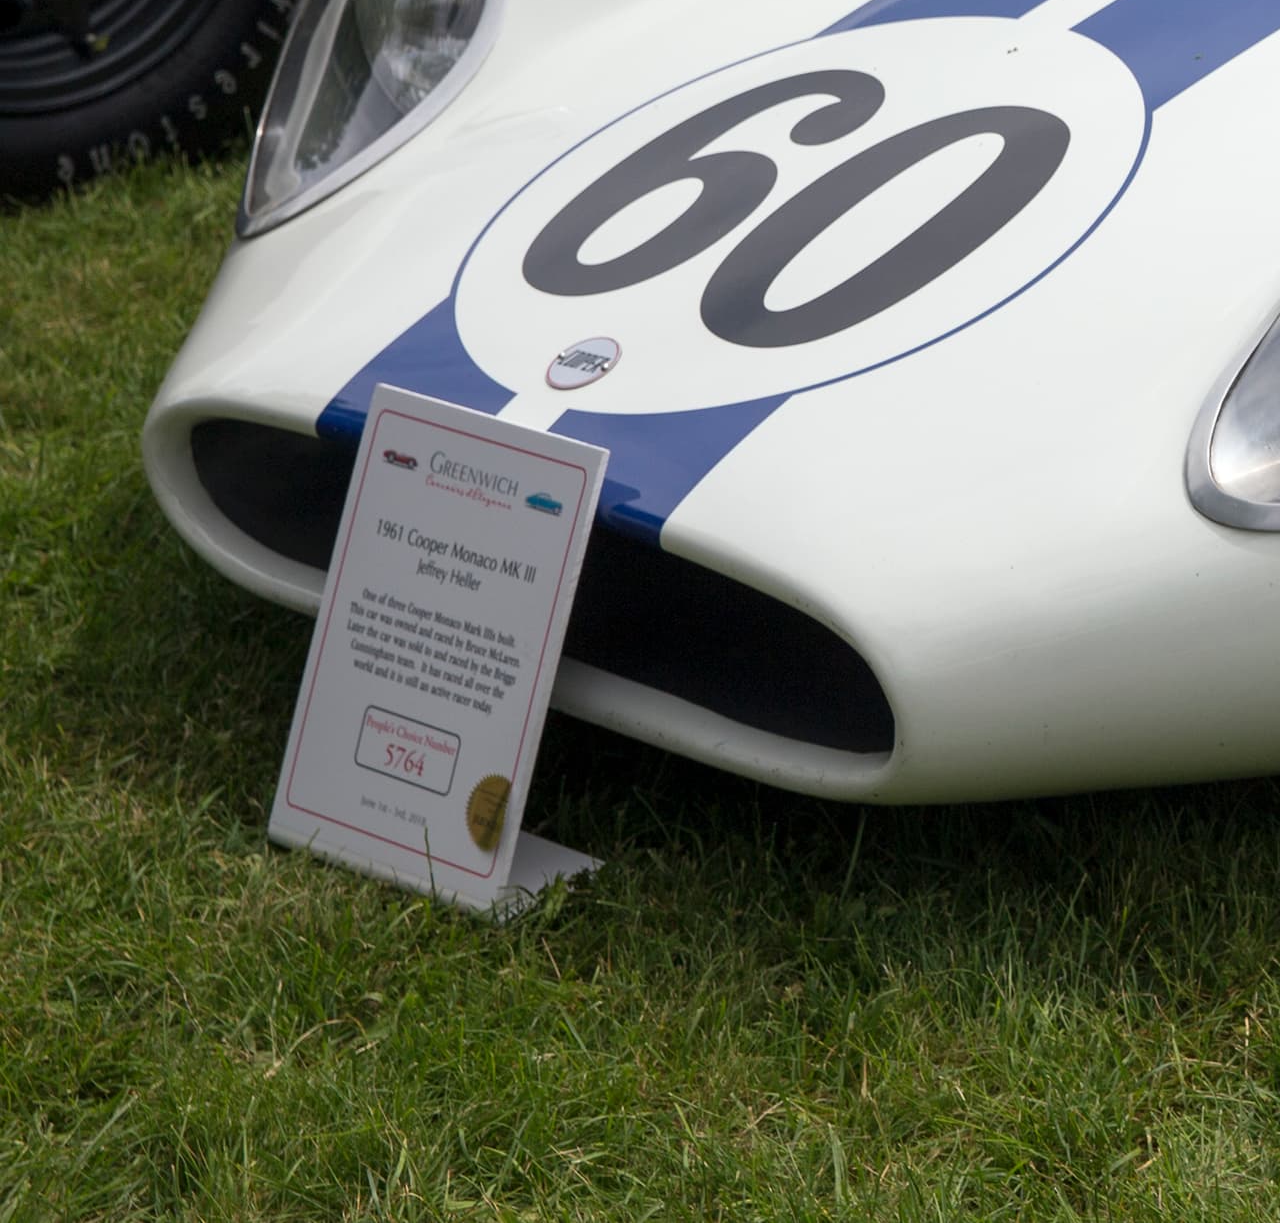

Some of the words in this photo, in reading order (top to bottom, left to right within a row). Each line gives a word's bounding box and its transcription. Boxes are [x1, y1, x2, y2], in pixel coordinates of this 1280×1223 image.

[522, 69, 1071, 348] 60
[377, 519, 404, 541] 1961
[407, 528, 449, 556] Cooper
[450, 542, 498, 571] Monaco
[500, 558, 522, 579] MK
[523, 565, 537, 584] III
[416, 558, 448, 585] Jeffrey
[449, 569, 481, 591] Heller
[350, 601, 365, 616] This
[366, 611, 378, 620] car
[380, 614, 393, 625] was
[394, 619, 418, 634] owned
[418, 627, 434, 639] and
[433, 632, 455, 646] raced
[455, 636, 464, 649] by
[465, 639, 487, 657] Bruce
[362, 588, 377, 602] One
[378, 593, 388, 605] of
[387, 596, 407, 612] three
[407, 602, 433, 621] Cooper
[434, 612, 462, 630] Monaco
[463, 621, 481, 637] Mark
[347, 619, 366, 634] Later
[366, 626, 379, 639] the
[380, 633, 392, 643] car
[393, 637, 406, 648] was
[408, 641, 424, 654] sold
[424, 646, 432, 657] to
[433, 650, 448, 662] and
[448, 655, 470, 669] raced
[470, 659, 479, 672] by
[480, 664, 493, 677] the
[493, 667, 516, 687] Briggs
[350, 638, 395, 663] Cunningham
[421, 661, 428, 673] It
[428, 664, 442, 678] has
[443, 671, 464, 686] raced
[464, 677, 474, 689] all
[475, 683, 491, 695] over
[492, 686, 505, 699] the
[353, 659, 374, 674] world
[374, 667, 389, 679] and
[390, 670, 396, 681] it
[396, 674, 403, 683] is
[405, 676, 419, 689] still
[419, 682, 429, 692] an
[430, 686, 451, 700] active
[452, 693, 472, 706] racer
[384, 743, 424, 777] 5764
